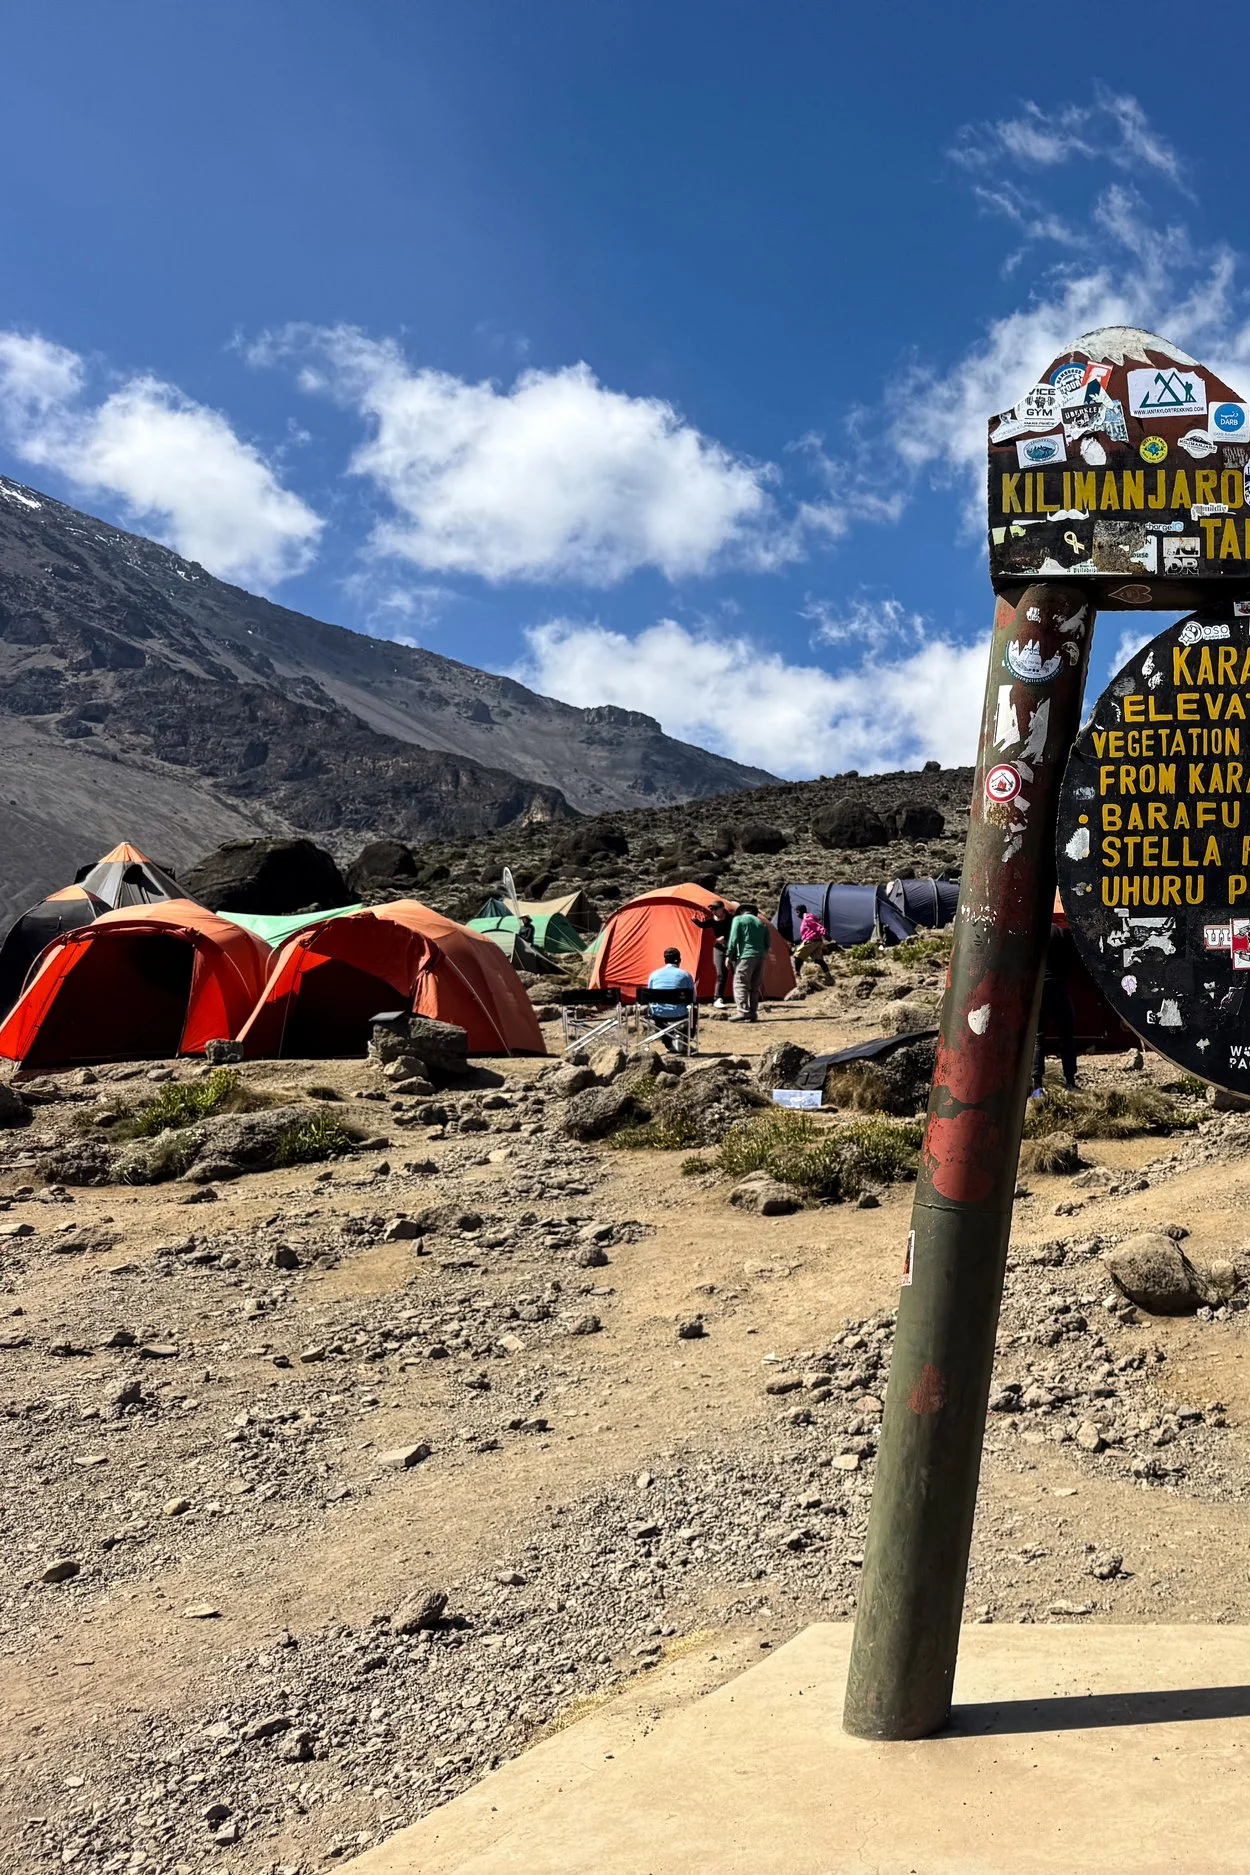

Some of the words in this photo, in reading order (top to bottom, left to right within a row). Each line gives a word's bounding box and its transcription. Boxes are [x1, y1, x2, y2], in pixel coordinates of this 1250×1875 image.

[1027, 408, 1053, 417] GYM
[1002, 468, 1243, 514] KILIMANJARO
[1203, 626, 1229, 636] OSO
[1092, 727, 1240, 758] VEGETATION
[1100, 763, 1177, 796] FROM
[1102, 800, 1240, 831] BARAFU
[1102, 835, 1222, 868] STELLA
[1102, 874, 1205, 907] UHURU
